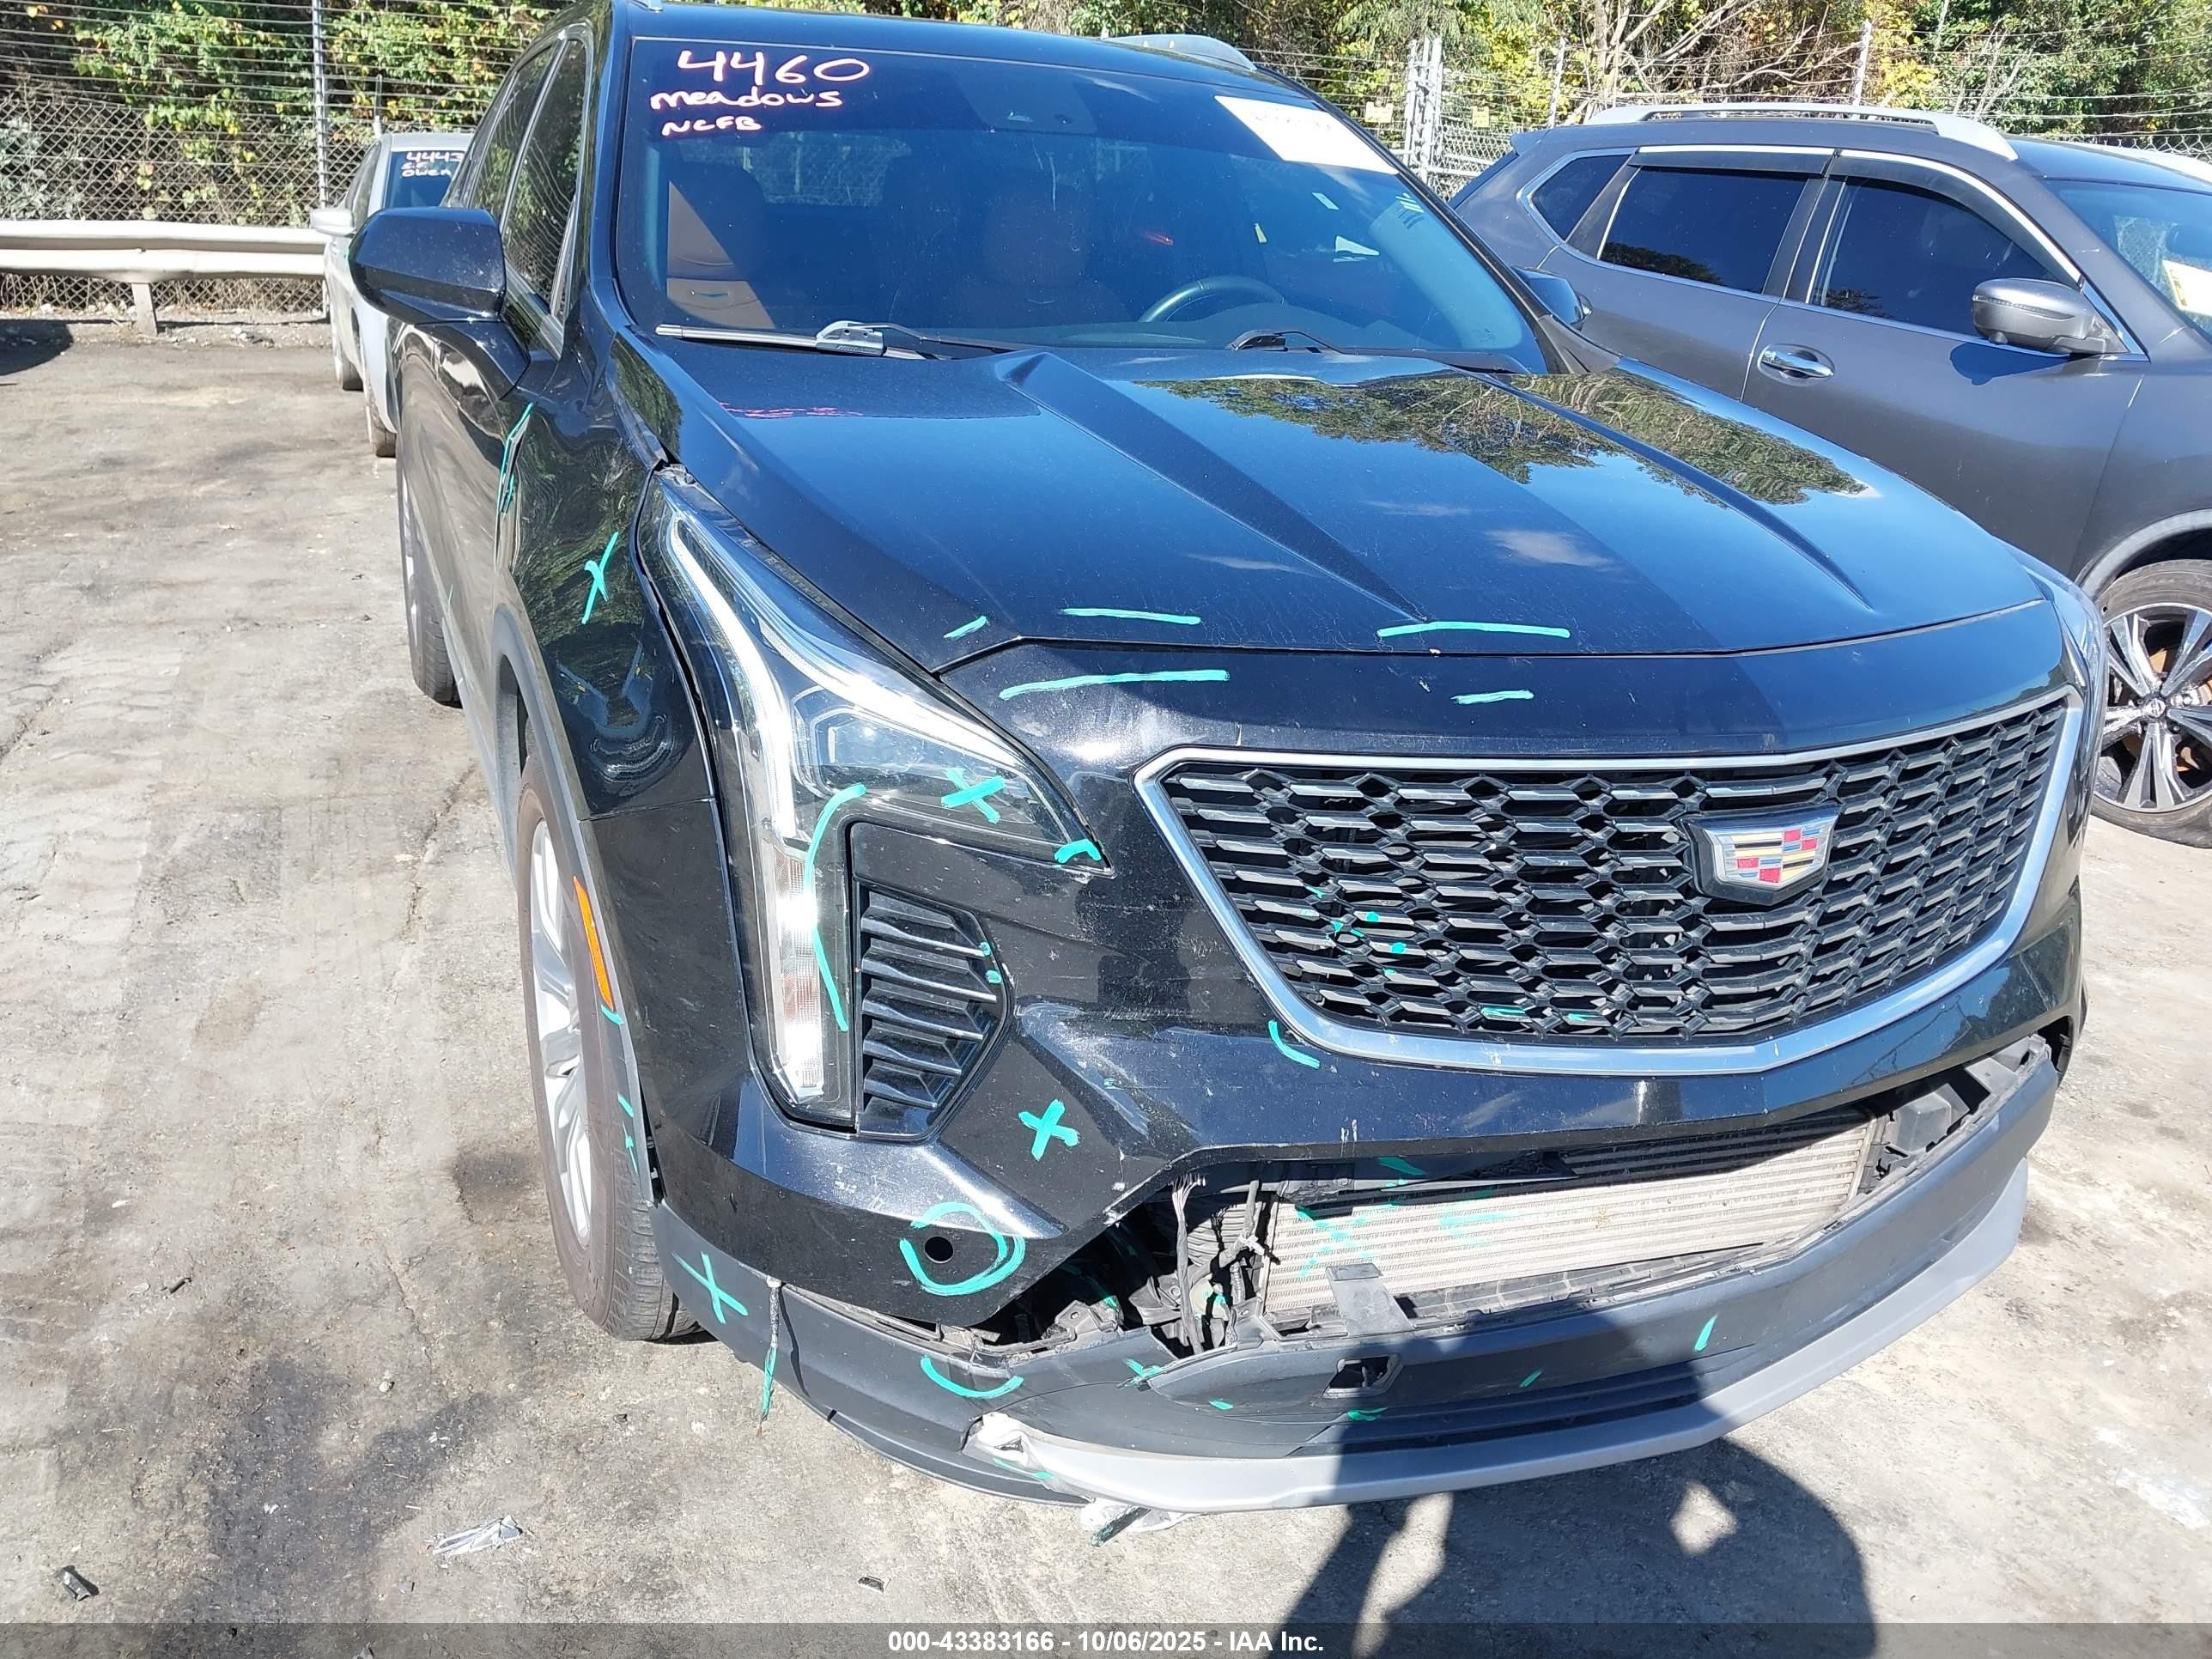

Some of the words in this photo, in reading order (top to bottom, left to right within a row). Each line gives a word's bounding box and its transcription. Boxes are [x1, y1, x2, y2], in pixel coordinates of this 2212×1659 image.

[677, 50, 870, 85] 4460
[660, 115, 763, 137] NCFB
[405, 150, 465, 163] 4443
